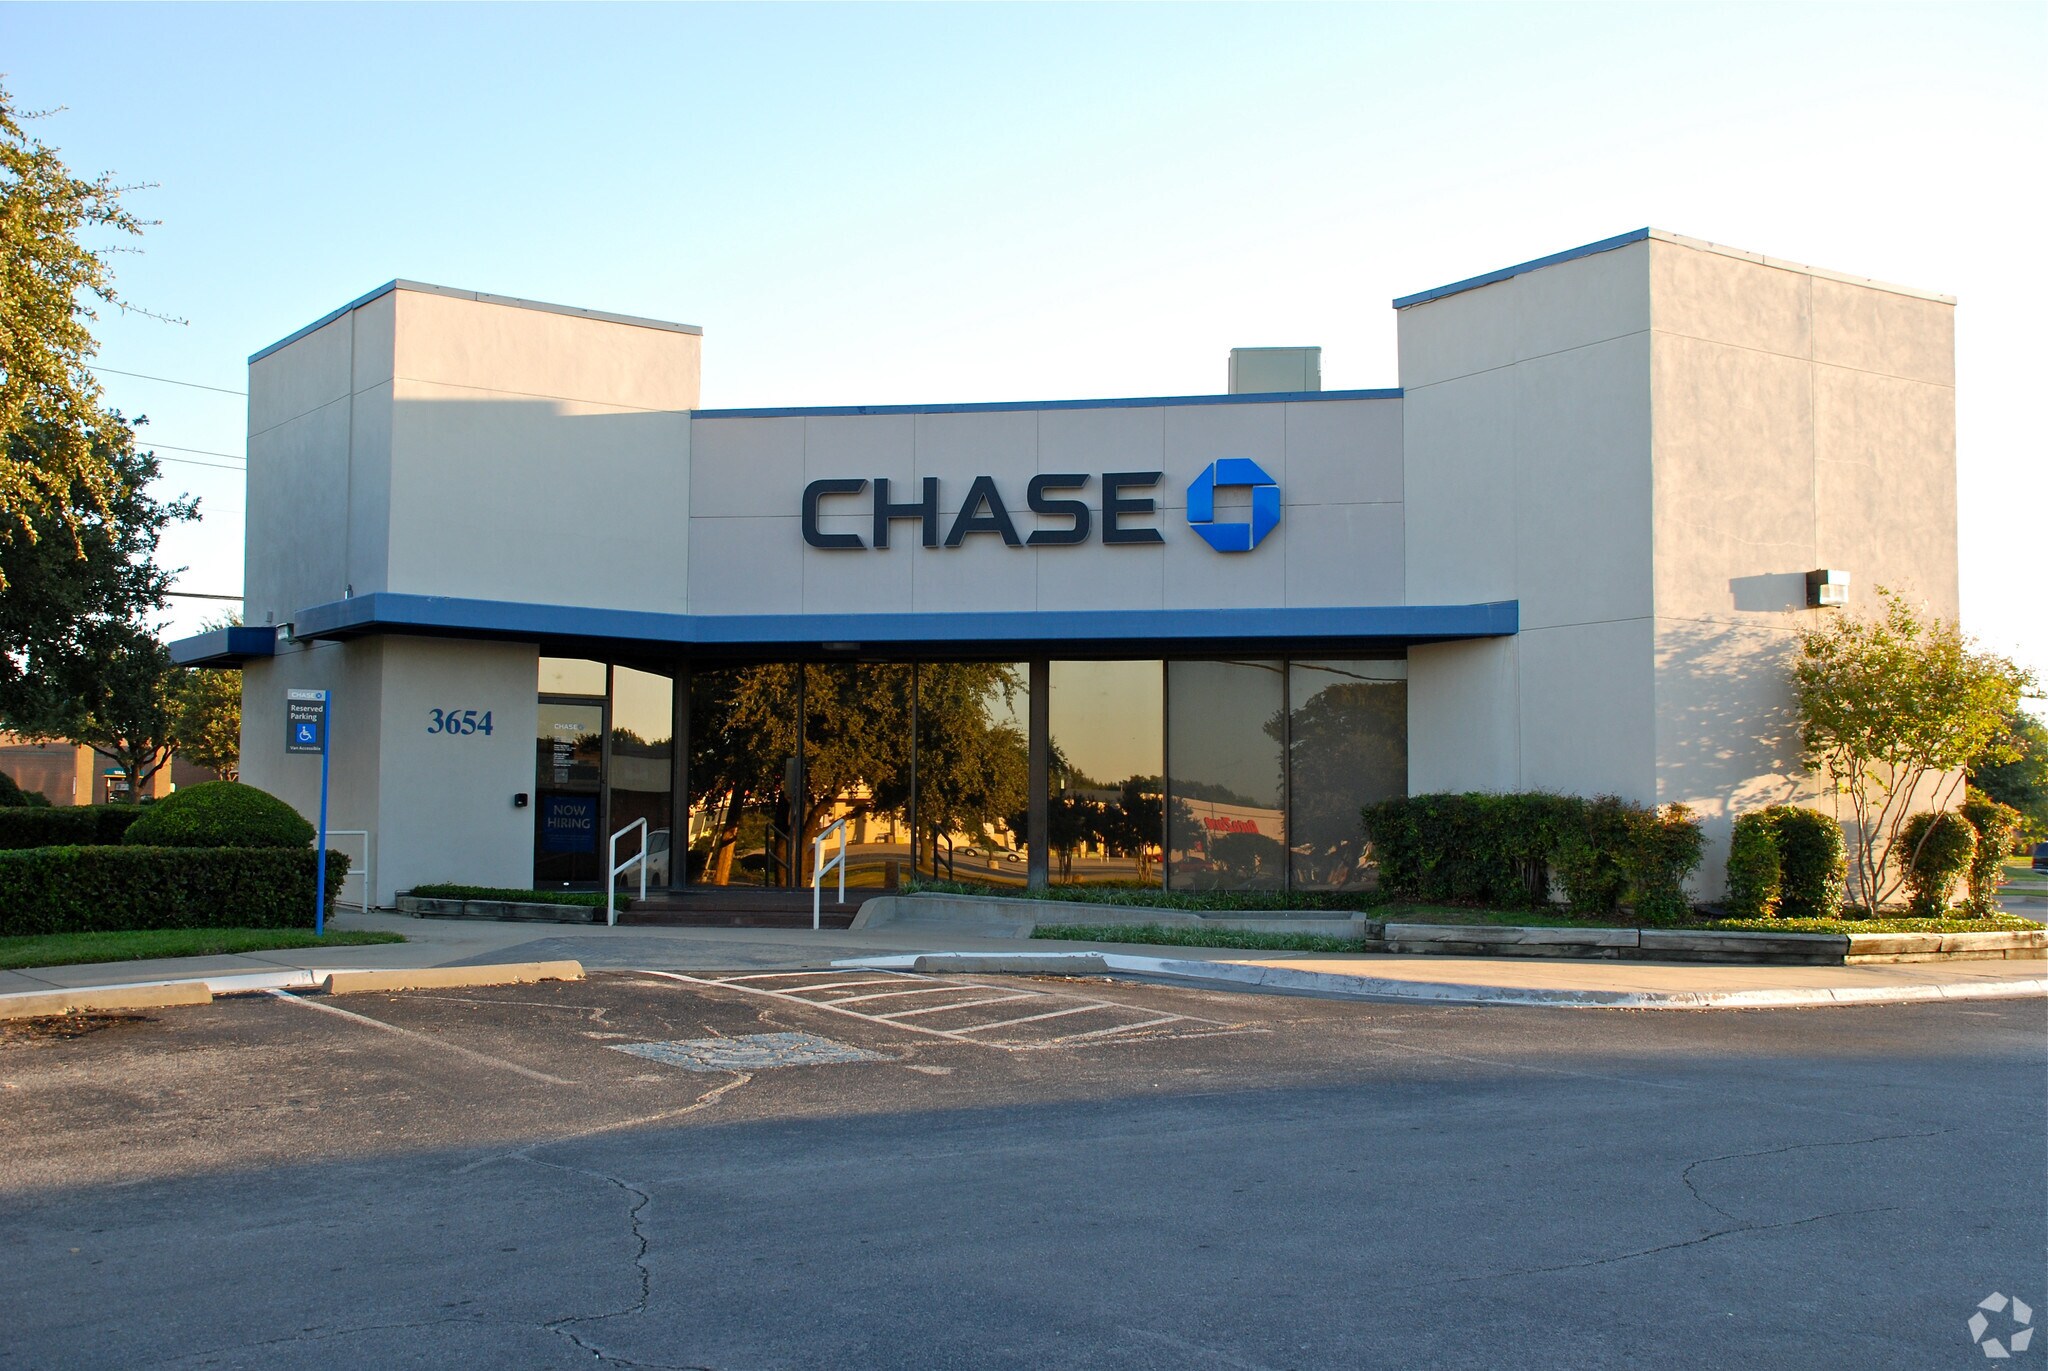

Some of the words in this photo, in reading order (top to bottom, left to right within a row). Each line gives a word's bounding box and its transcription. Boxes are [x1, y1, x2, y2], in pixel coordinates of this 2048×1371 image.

[801, 471, 1166, 550] CHASE
[290, 704, 323, 713] Reserved
[290, 713, 318, 722] Parking
[427, 708, 494, 736] 3654
[553, 804, 587, 817] NOW
[547, 816, 591, 829] HIRING
